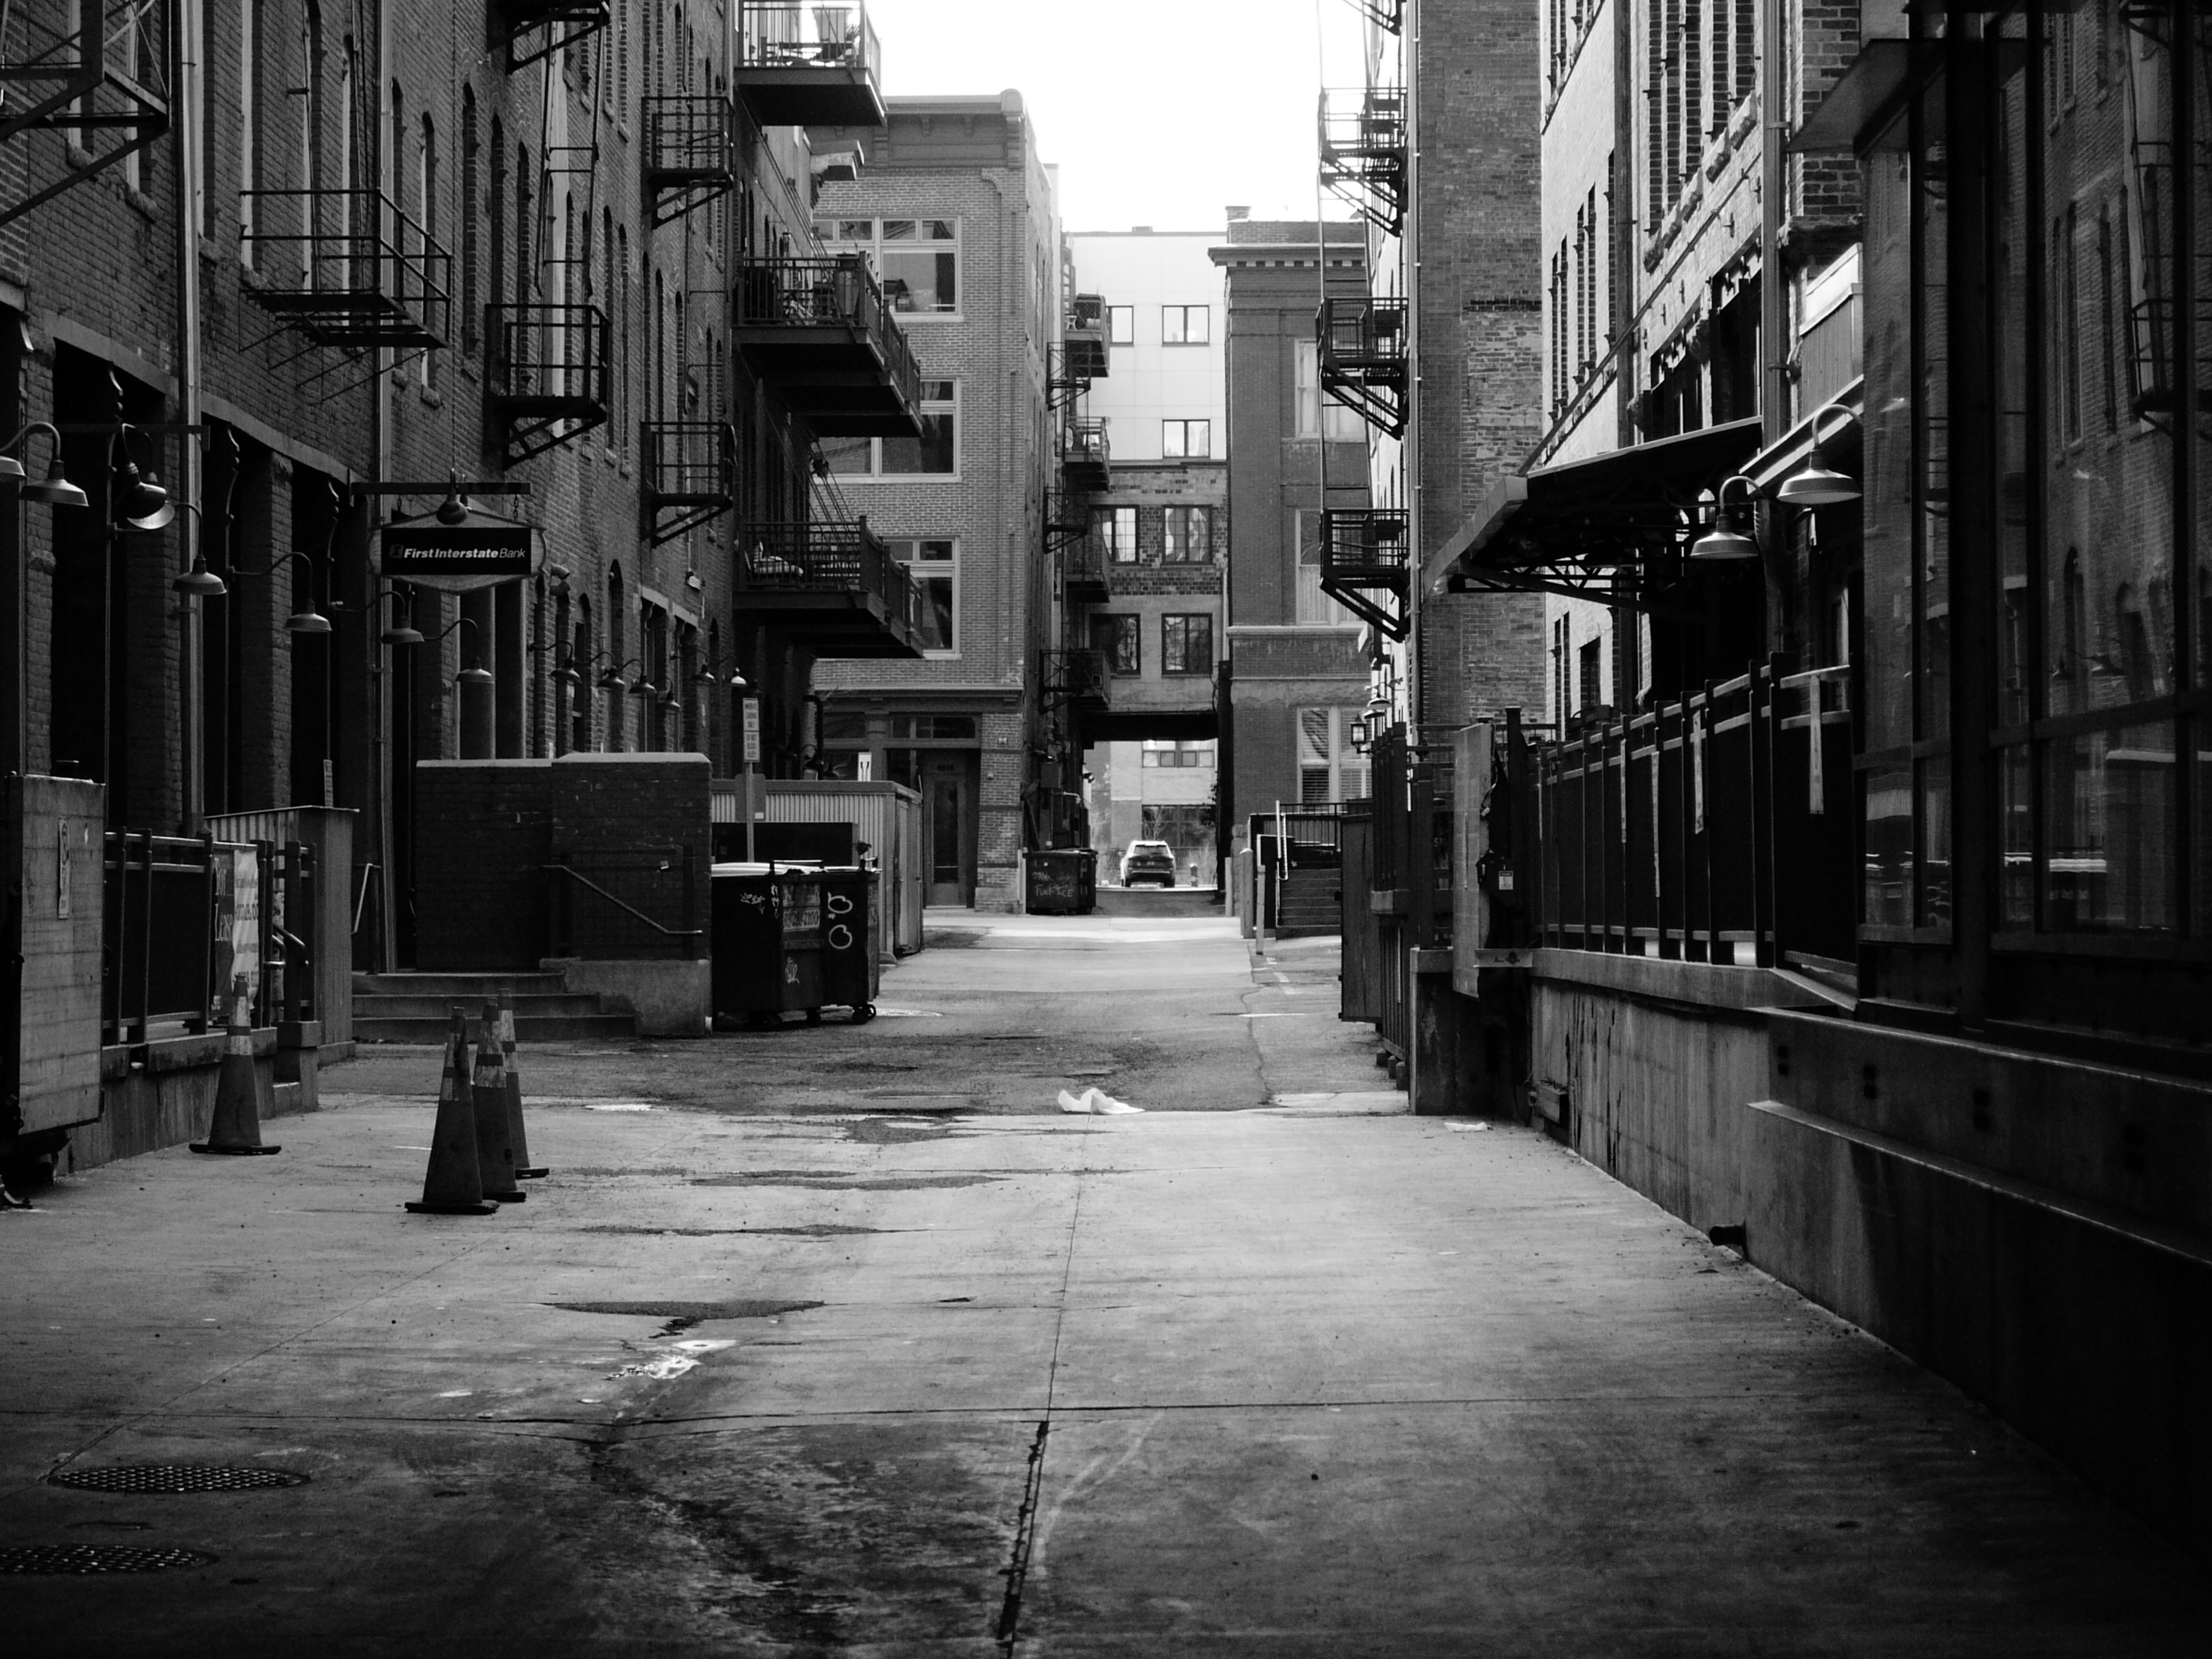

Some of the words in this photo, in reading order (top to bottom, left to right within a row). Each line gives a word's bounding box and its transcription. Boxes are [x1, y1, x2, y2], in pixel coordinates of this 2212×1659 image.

[403, 547, 435, 559] First
[435, 548, 499, 559] Interstate
[499, 547, 526, 559] Bank
